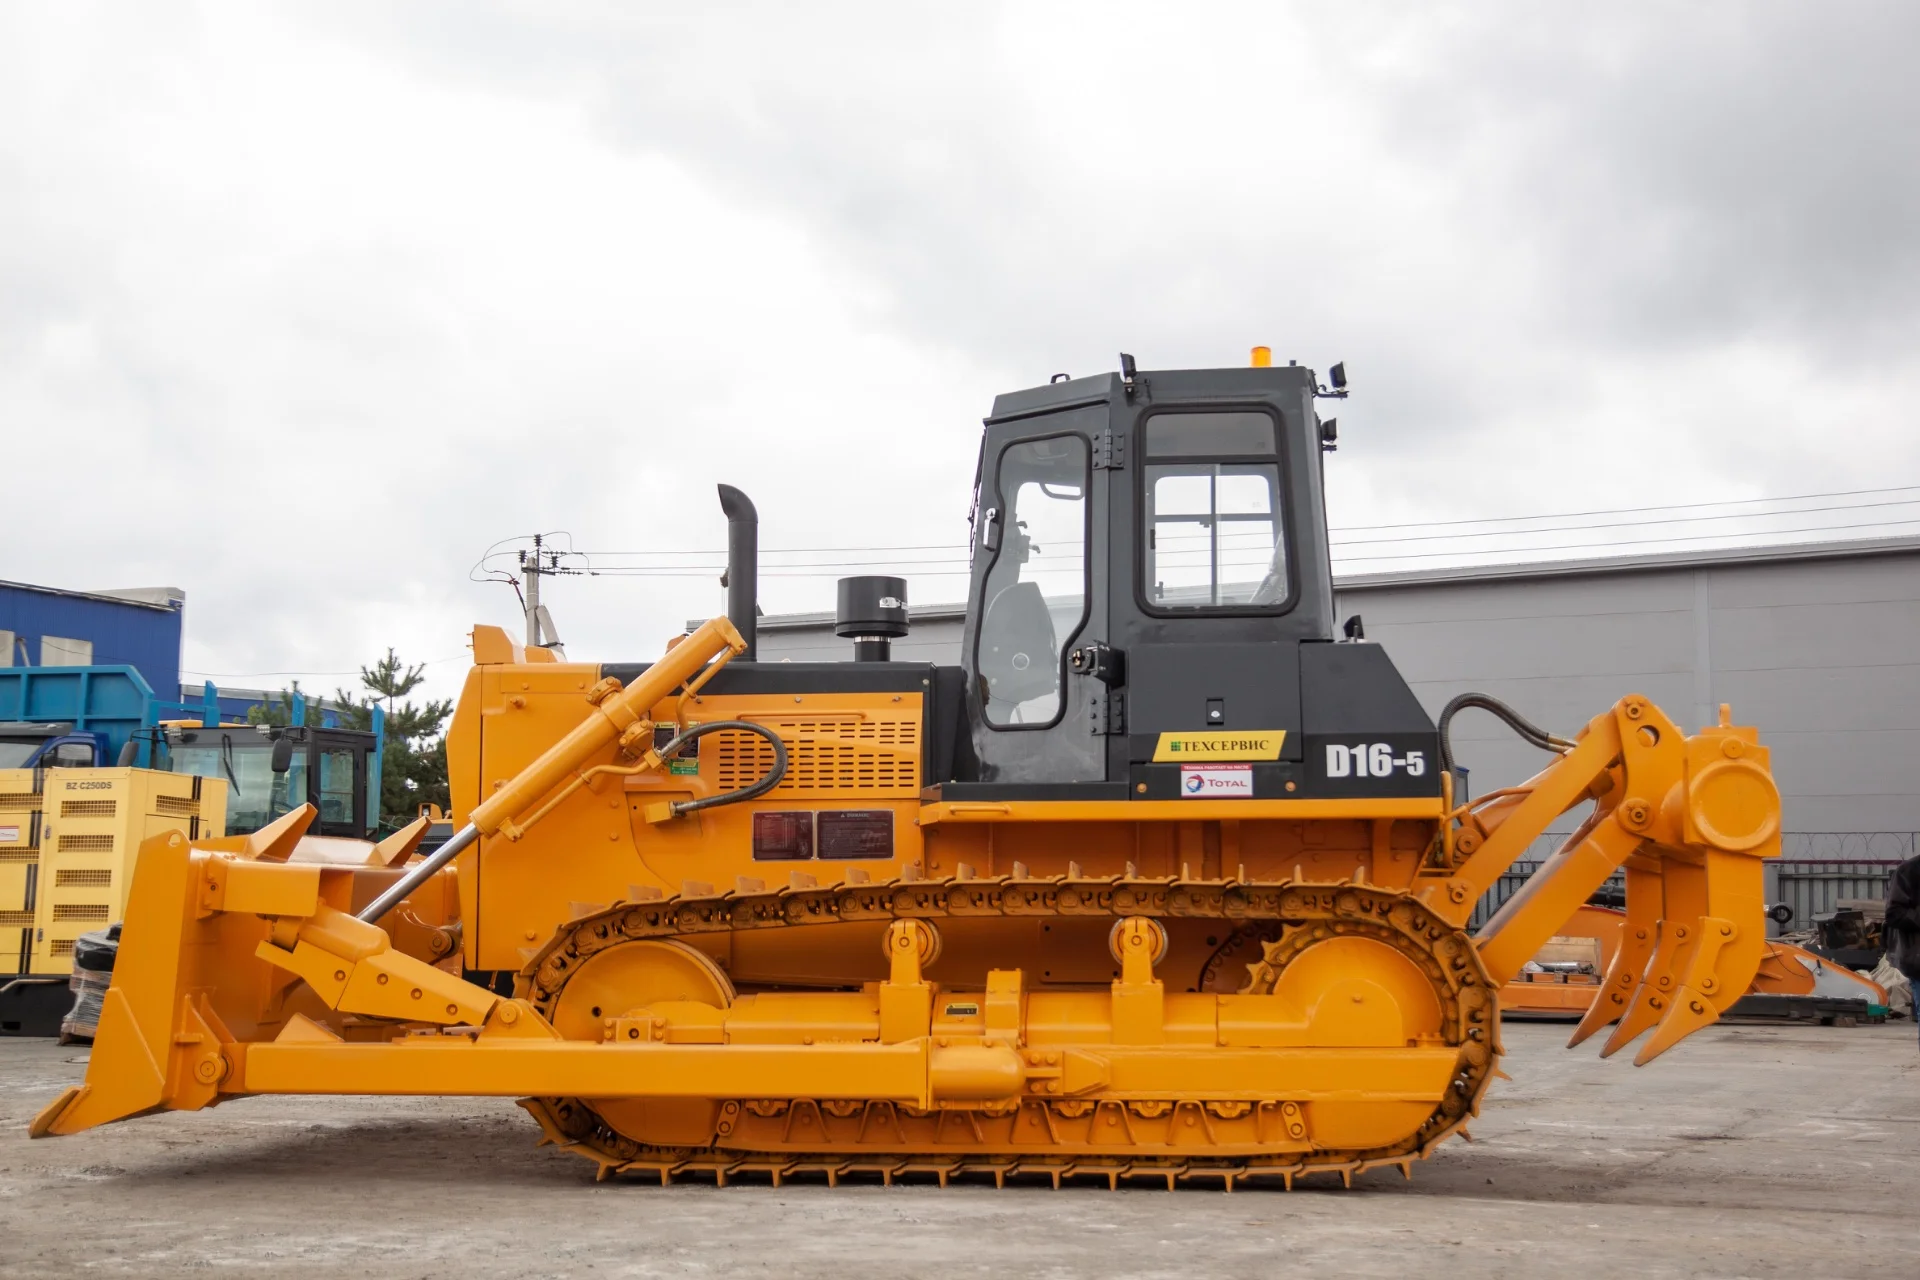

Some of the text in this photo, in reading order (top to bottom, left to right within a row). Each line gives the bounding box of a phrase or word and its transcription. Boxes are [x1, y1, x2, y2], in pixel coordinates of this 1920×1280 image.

[1181, 740, 1269, 752] ТЕХСЕРВИС
[1326, 743, 1425, 777] D16-5
[1207, 779, 1248, 788] TOTAL
